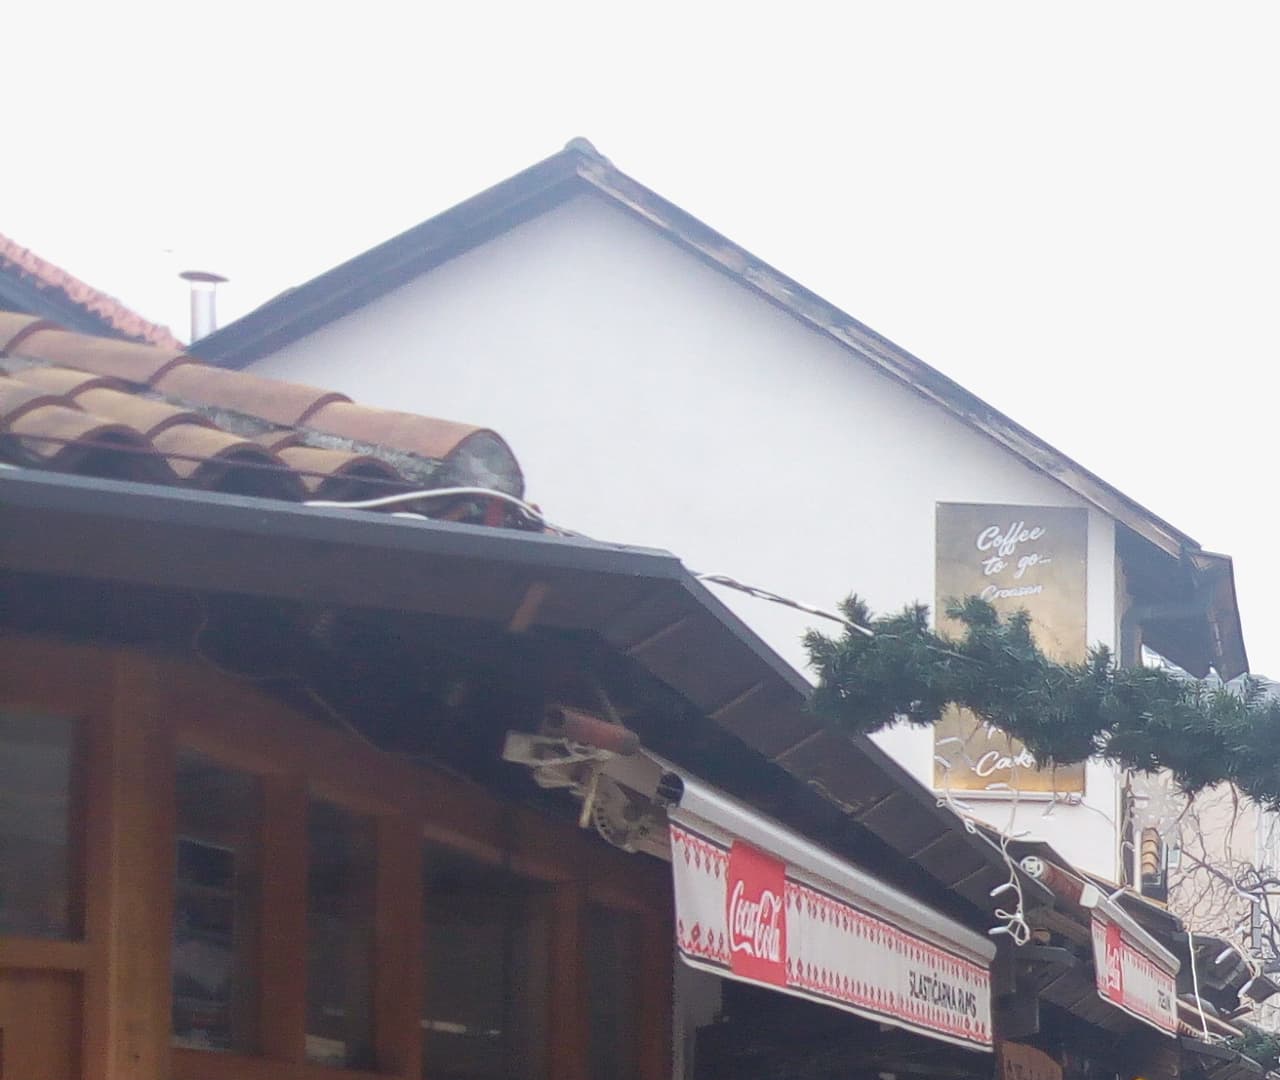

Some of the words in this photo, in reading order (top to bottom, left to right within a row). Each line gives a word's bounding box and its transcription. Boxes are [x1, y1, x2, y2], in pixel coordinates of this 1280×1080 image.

[977, 521, 1046, 557] Coffee
[982, 556, 1008, 575] to
[729, 880, 782, 962] Coca-Cola
